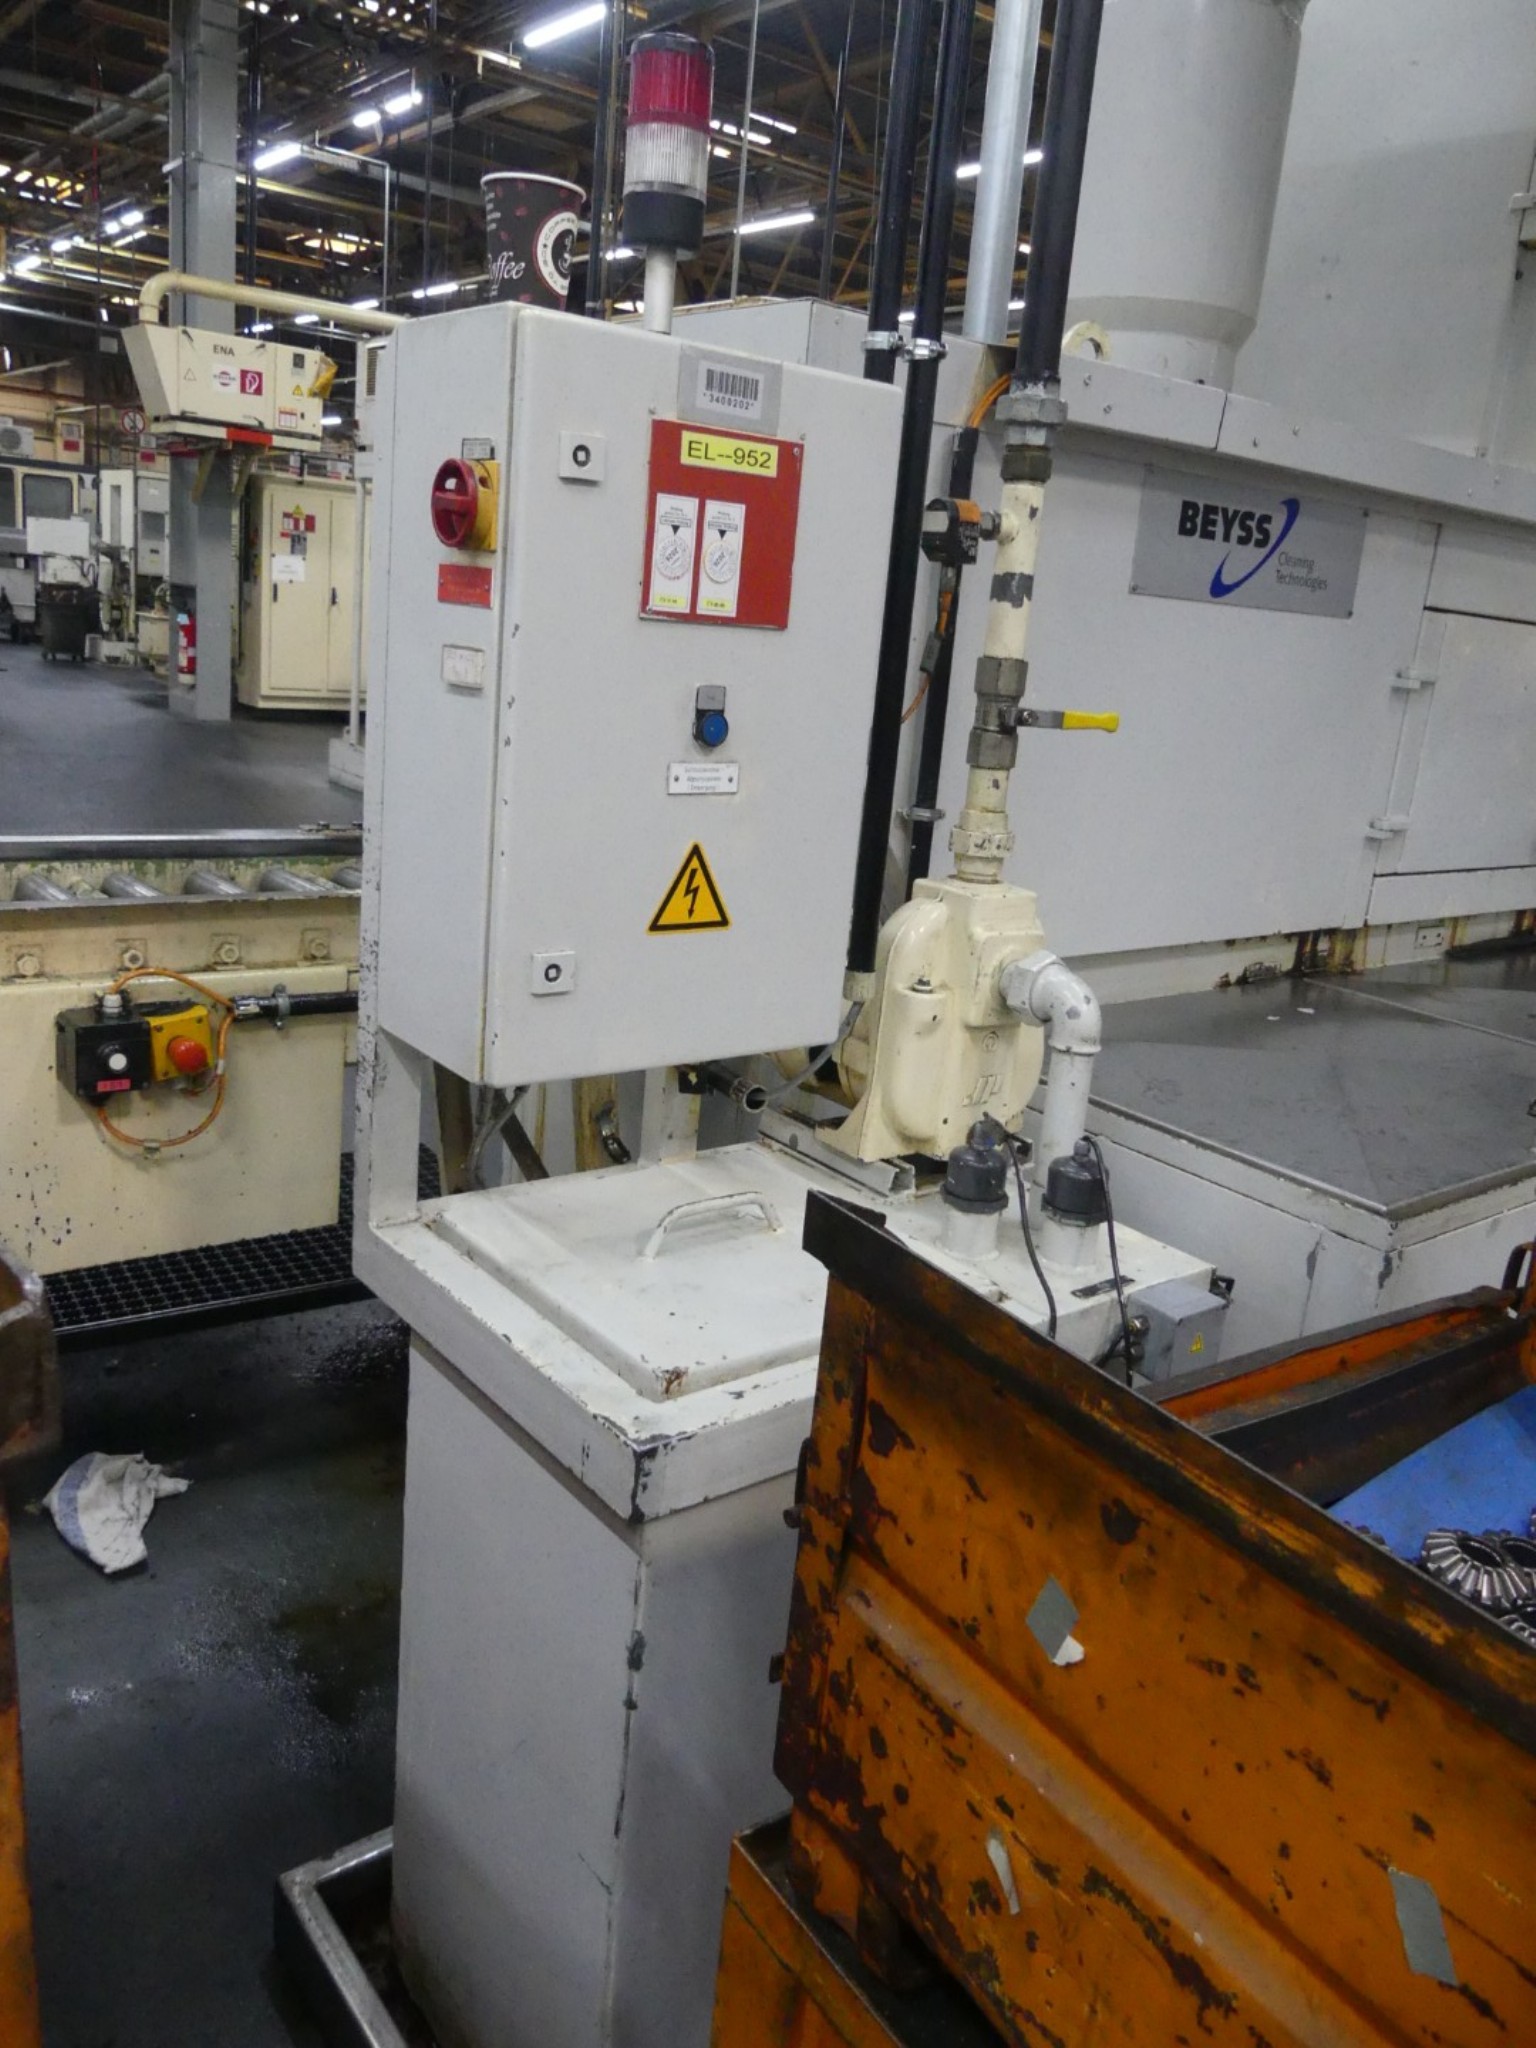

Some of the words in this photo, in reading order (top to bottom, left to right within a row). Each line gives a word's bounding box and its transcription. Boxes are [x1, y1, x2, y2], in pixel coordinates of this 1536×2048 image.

[213, 344, 235, 357] ENA
[1177, 499, 1273, 548] BEYSS
[1276, 569, 1328, 592] Technologies
